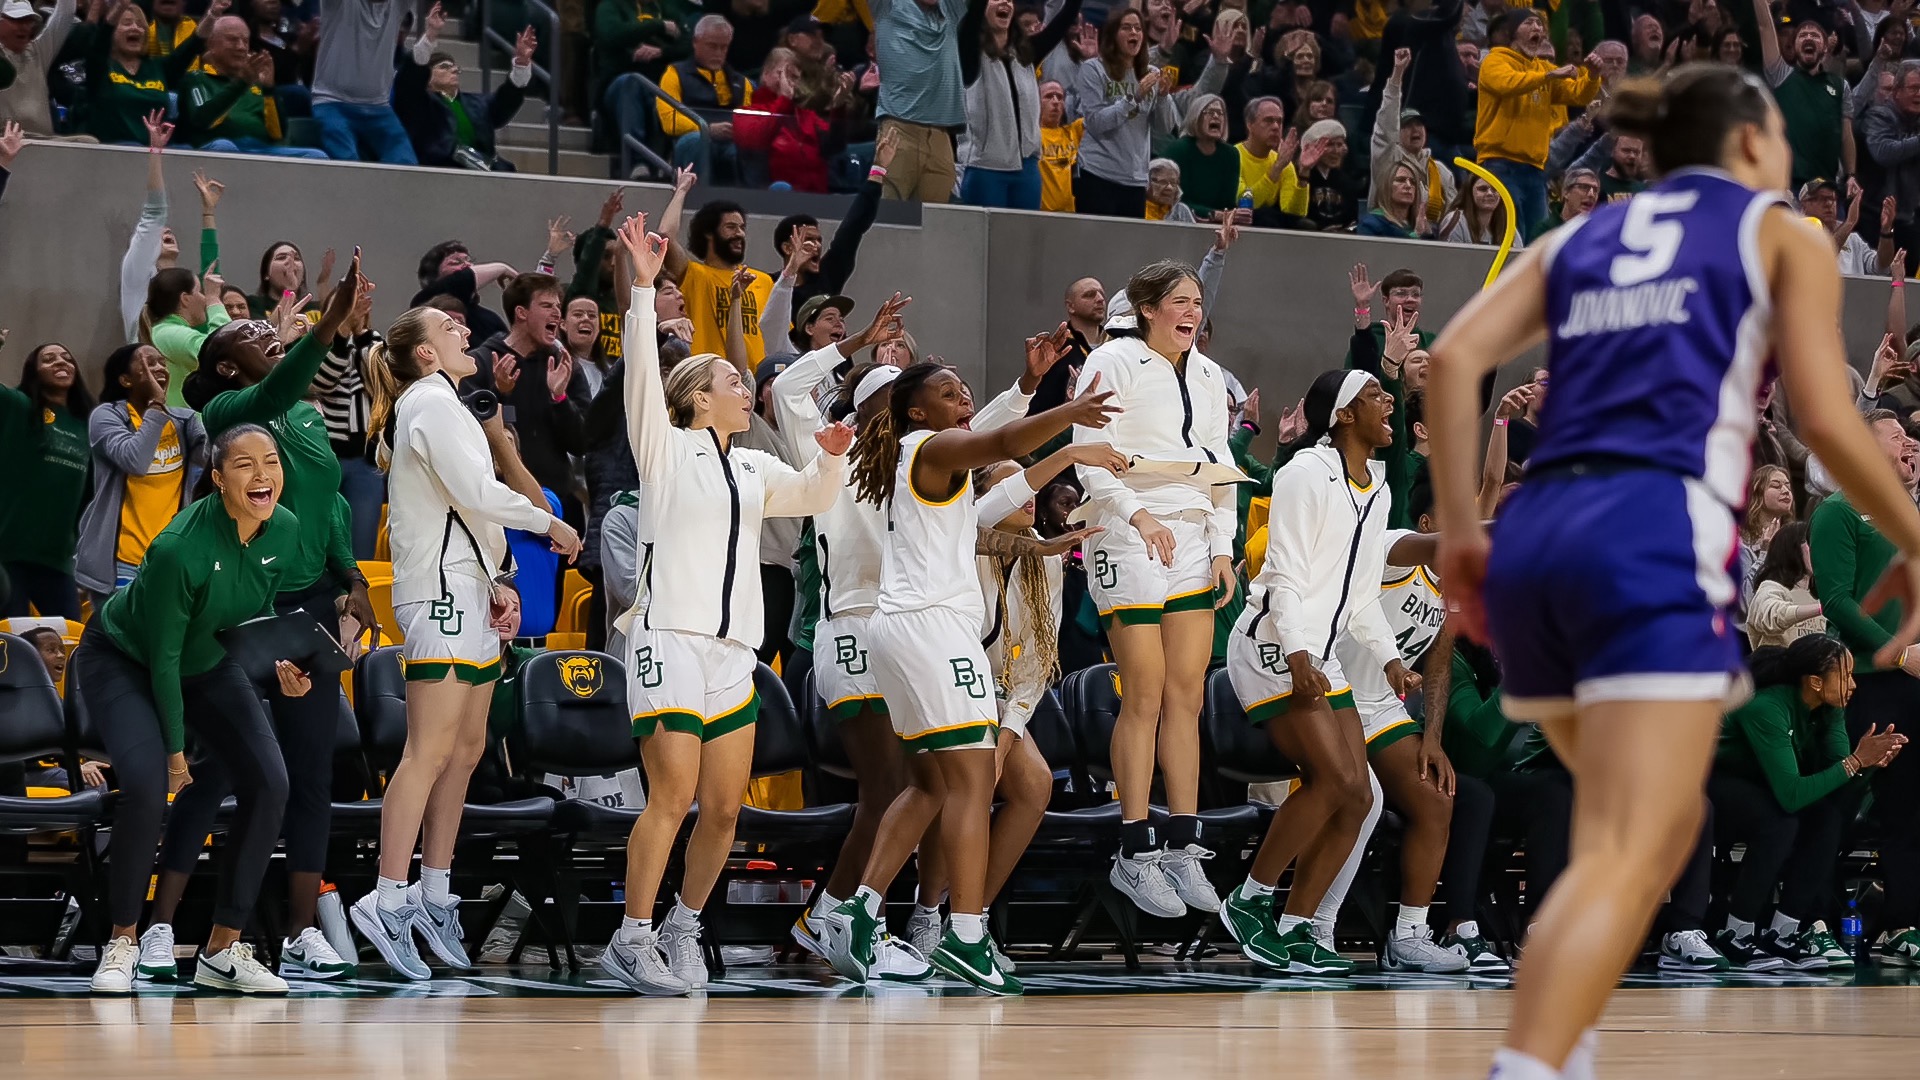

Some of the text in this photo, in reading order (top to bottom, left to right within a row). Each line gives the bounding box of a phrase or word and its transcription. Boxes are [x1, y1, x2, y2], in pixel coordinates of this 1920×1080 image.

[1609, 190, 1700, 287] 5
[716, 286, 758, 309] BAYOR
[1094, 550, 1118, 589] BU
[429, 592, 465, 635] BU
[635, 645, 664, 688] BU
[834, 634, 868, 675] BU
[1258, 643, 1290, 675] BU
[949, 657, 987, 698] BU
